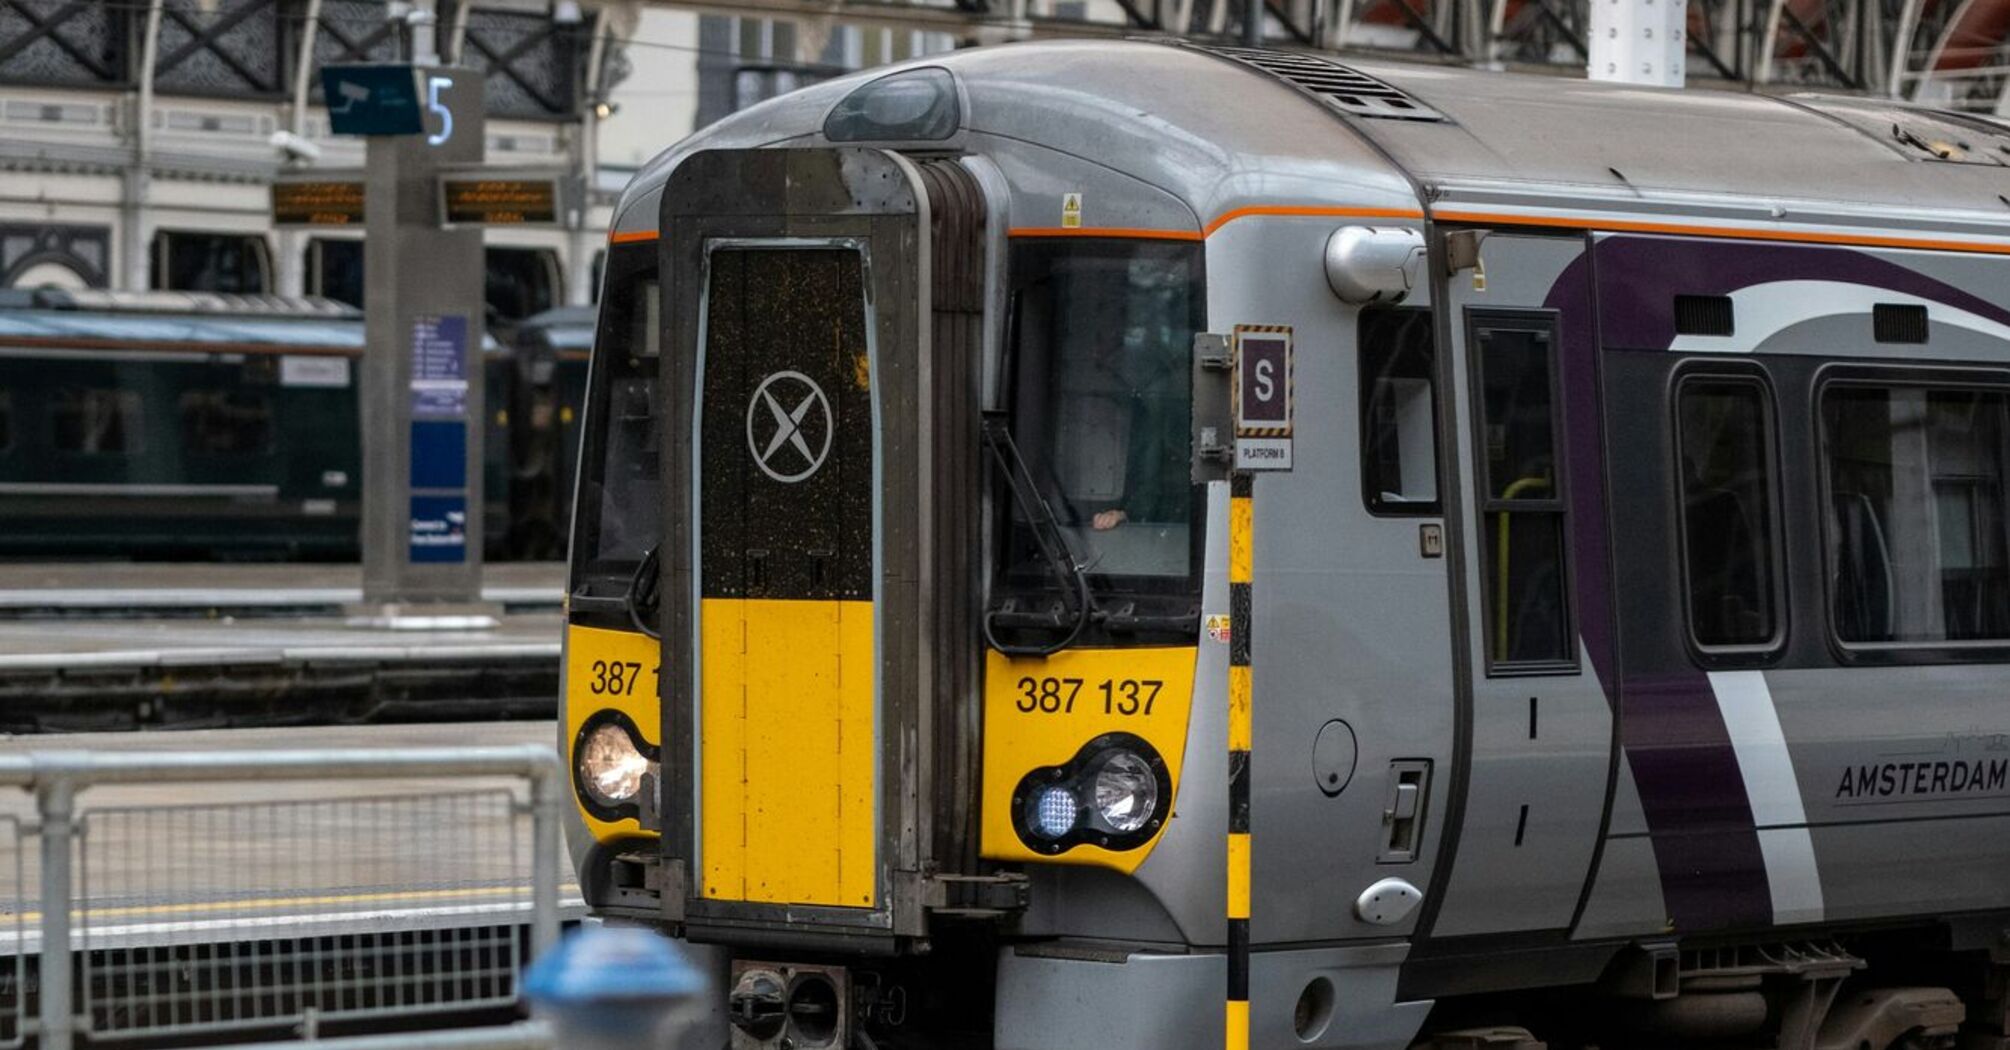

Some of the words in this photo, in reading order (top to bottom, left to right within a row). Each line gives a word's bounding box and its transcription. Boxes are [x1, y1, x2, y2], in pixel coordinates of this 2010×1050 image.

[428, 77, 453, 146] 5
[1255, 358, 1274, 402] S
[1243, 447, 1279, 459] PLATFORM
[591, 660, 642, 696] 387
[1016, 676, 1084, 714] 387
[1098, 679, 1164, 716] 137
[1835, 759, 2008, 798] AMSTERDAM
